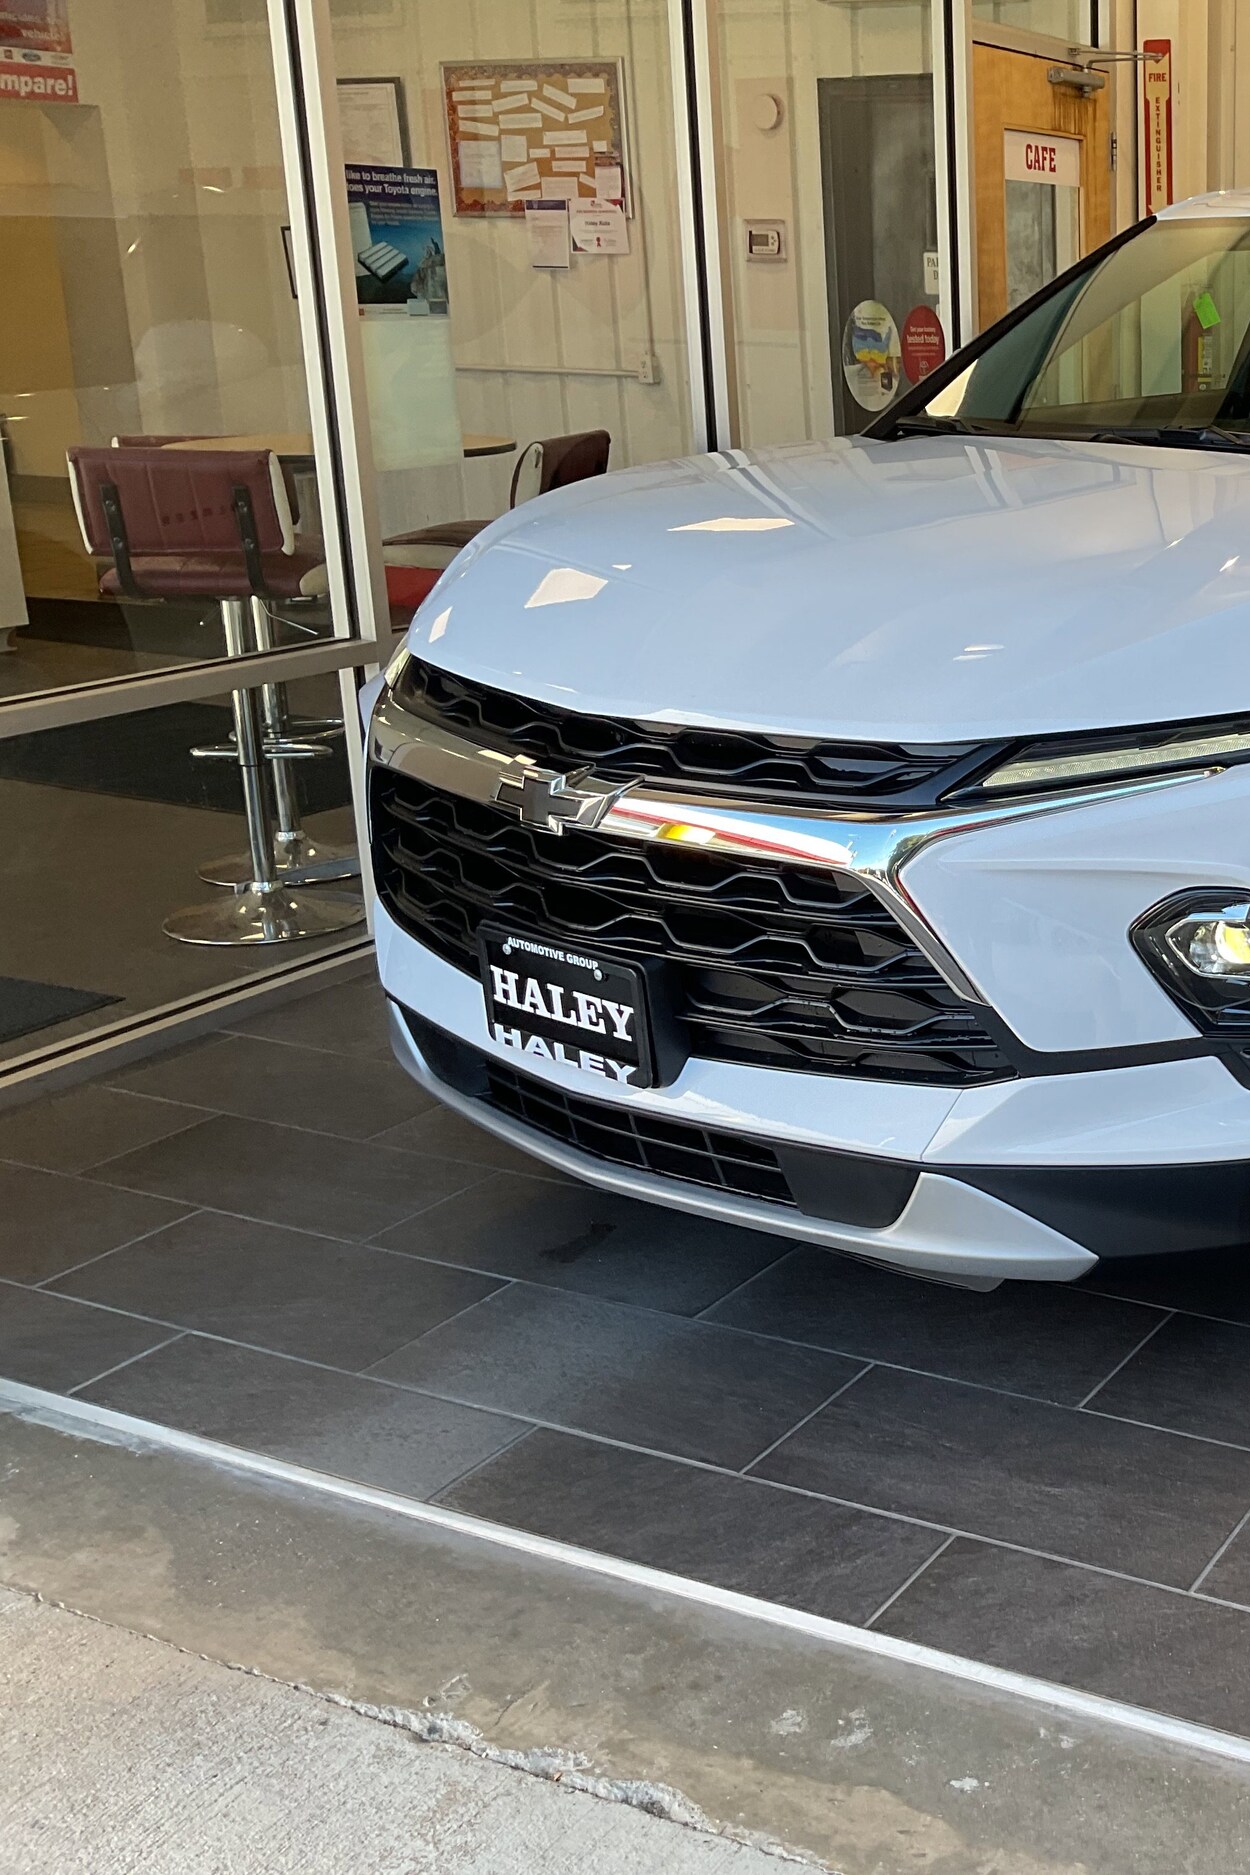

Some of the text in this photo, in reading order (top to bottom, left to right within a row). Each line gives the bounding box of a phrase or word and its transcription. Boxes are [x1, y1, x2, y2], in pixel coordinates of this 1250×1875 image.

[1148, 73, 1167, 83] FIRE
[1025, 143, 1057, 173] CAFE
[372, 172, 402, 183] breathe
[383, 184, 410, 195] Toyota
[508, 936, 599, 970] AUTOMOTIVE GROUP
[489, 964, 634, 1042] HALEY
[494, 1023, 637, 1084] HALEY
